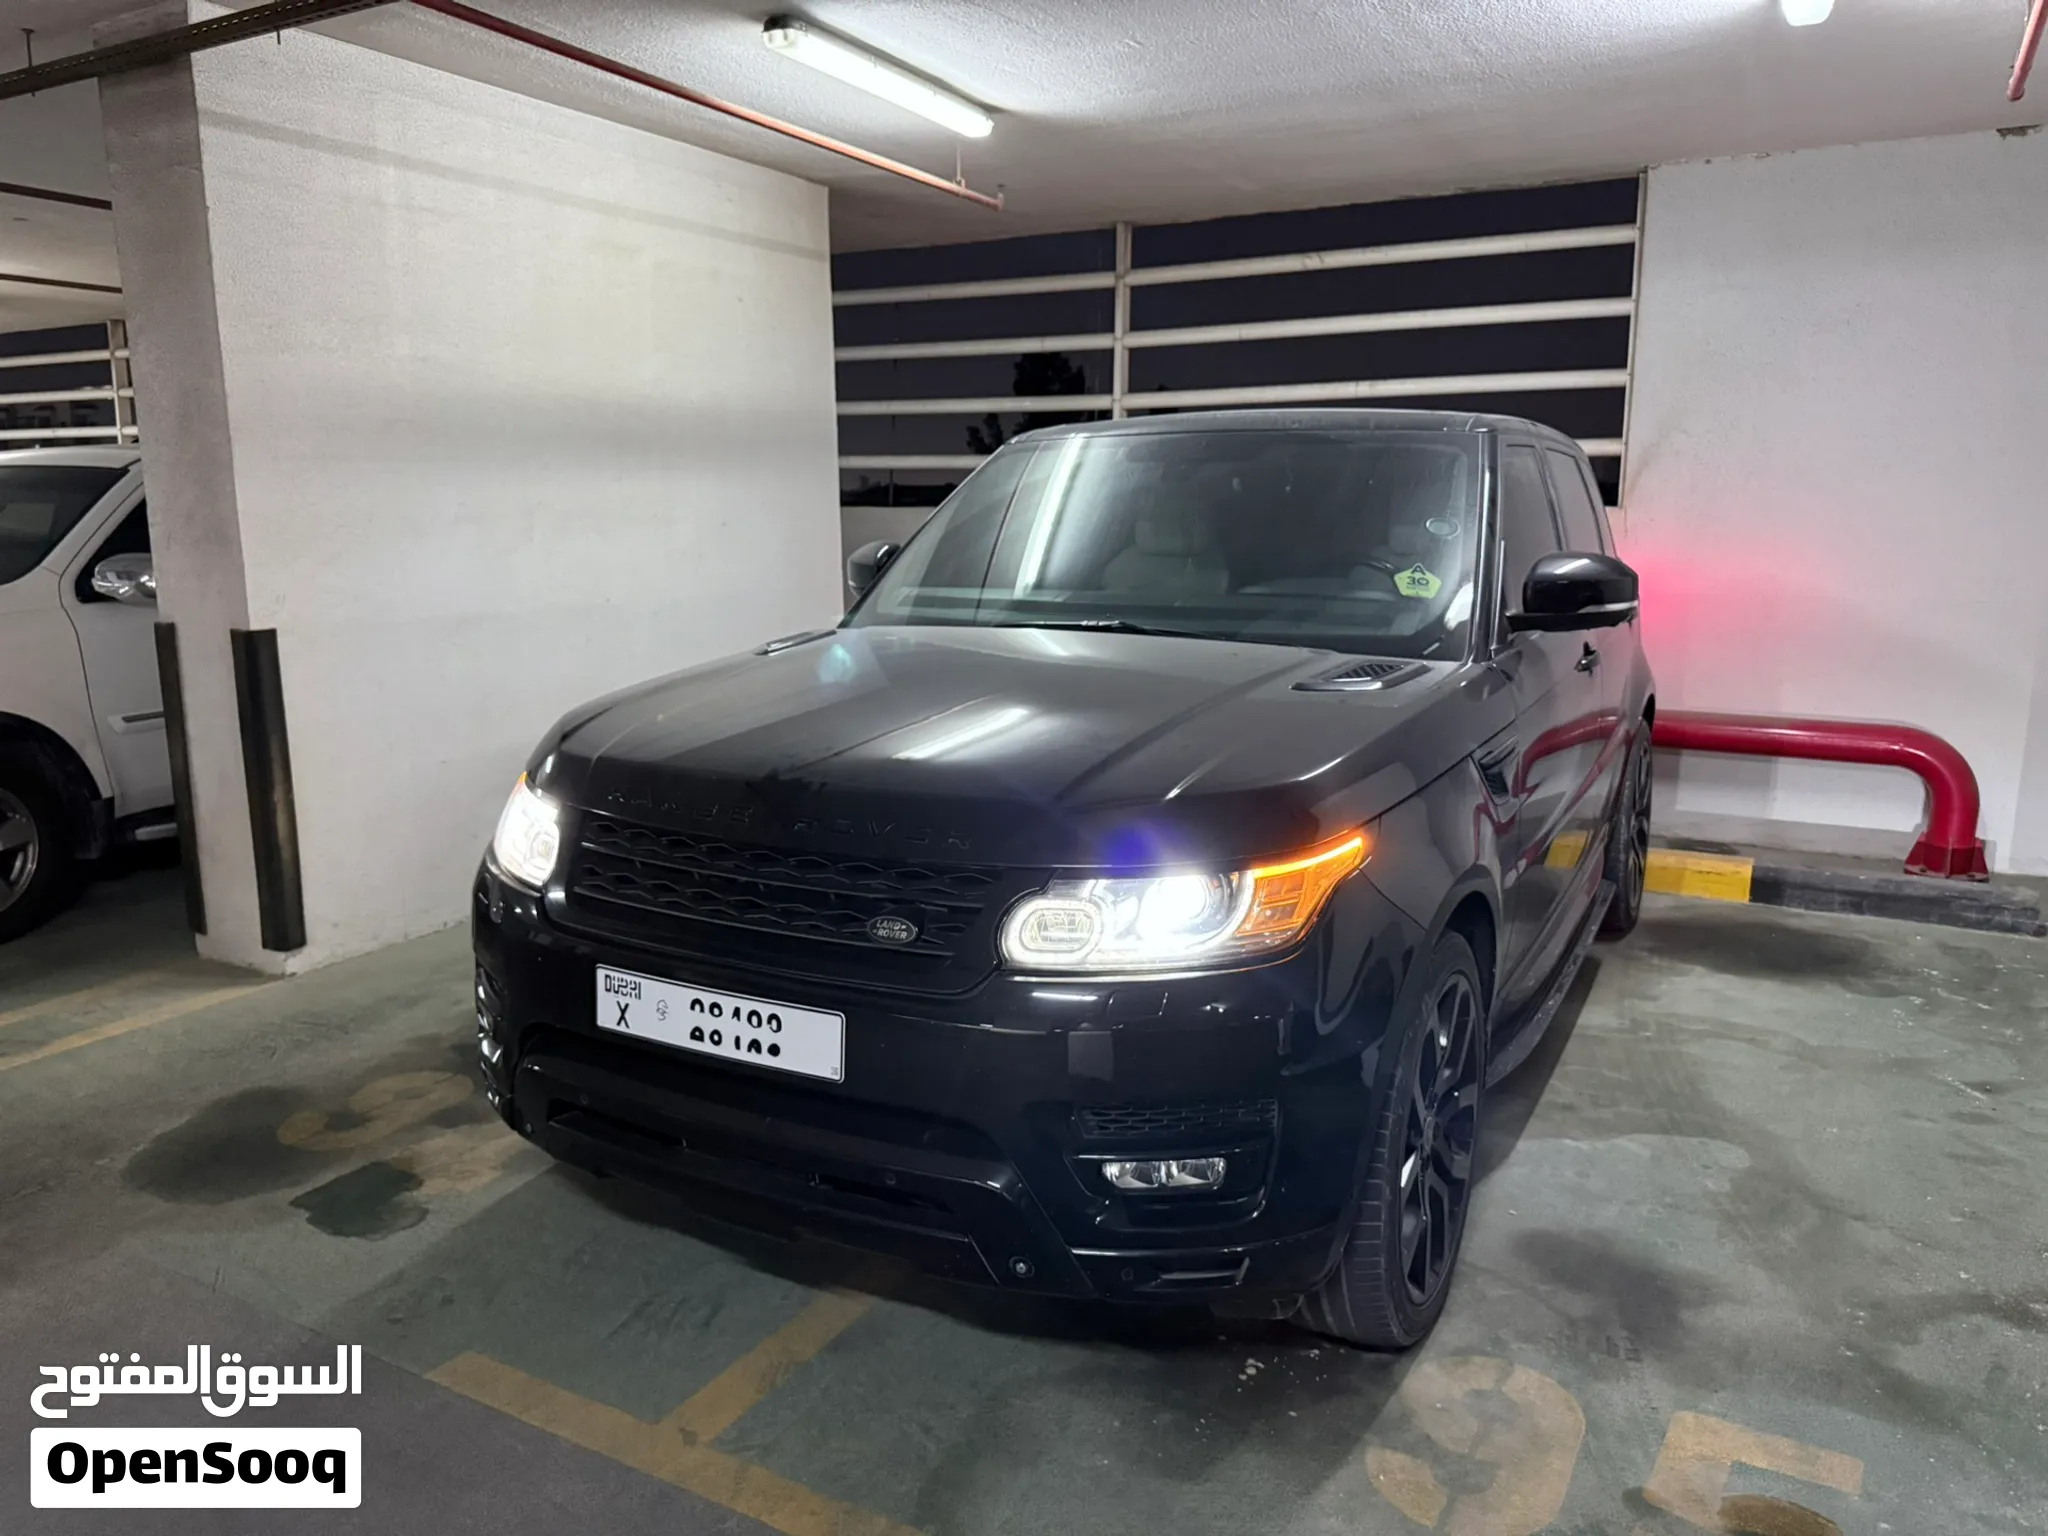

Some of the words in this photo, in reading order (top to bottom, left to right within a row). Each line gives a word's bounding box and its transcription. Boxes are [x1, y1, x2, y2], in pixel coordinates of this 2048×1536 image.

[876, 919, 901, 930] LAND
[876, 928, 908, 940] ROVER
[616, 1000, 630, 1029] X
